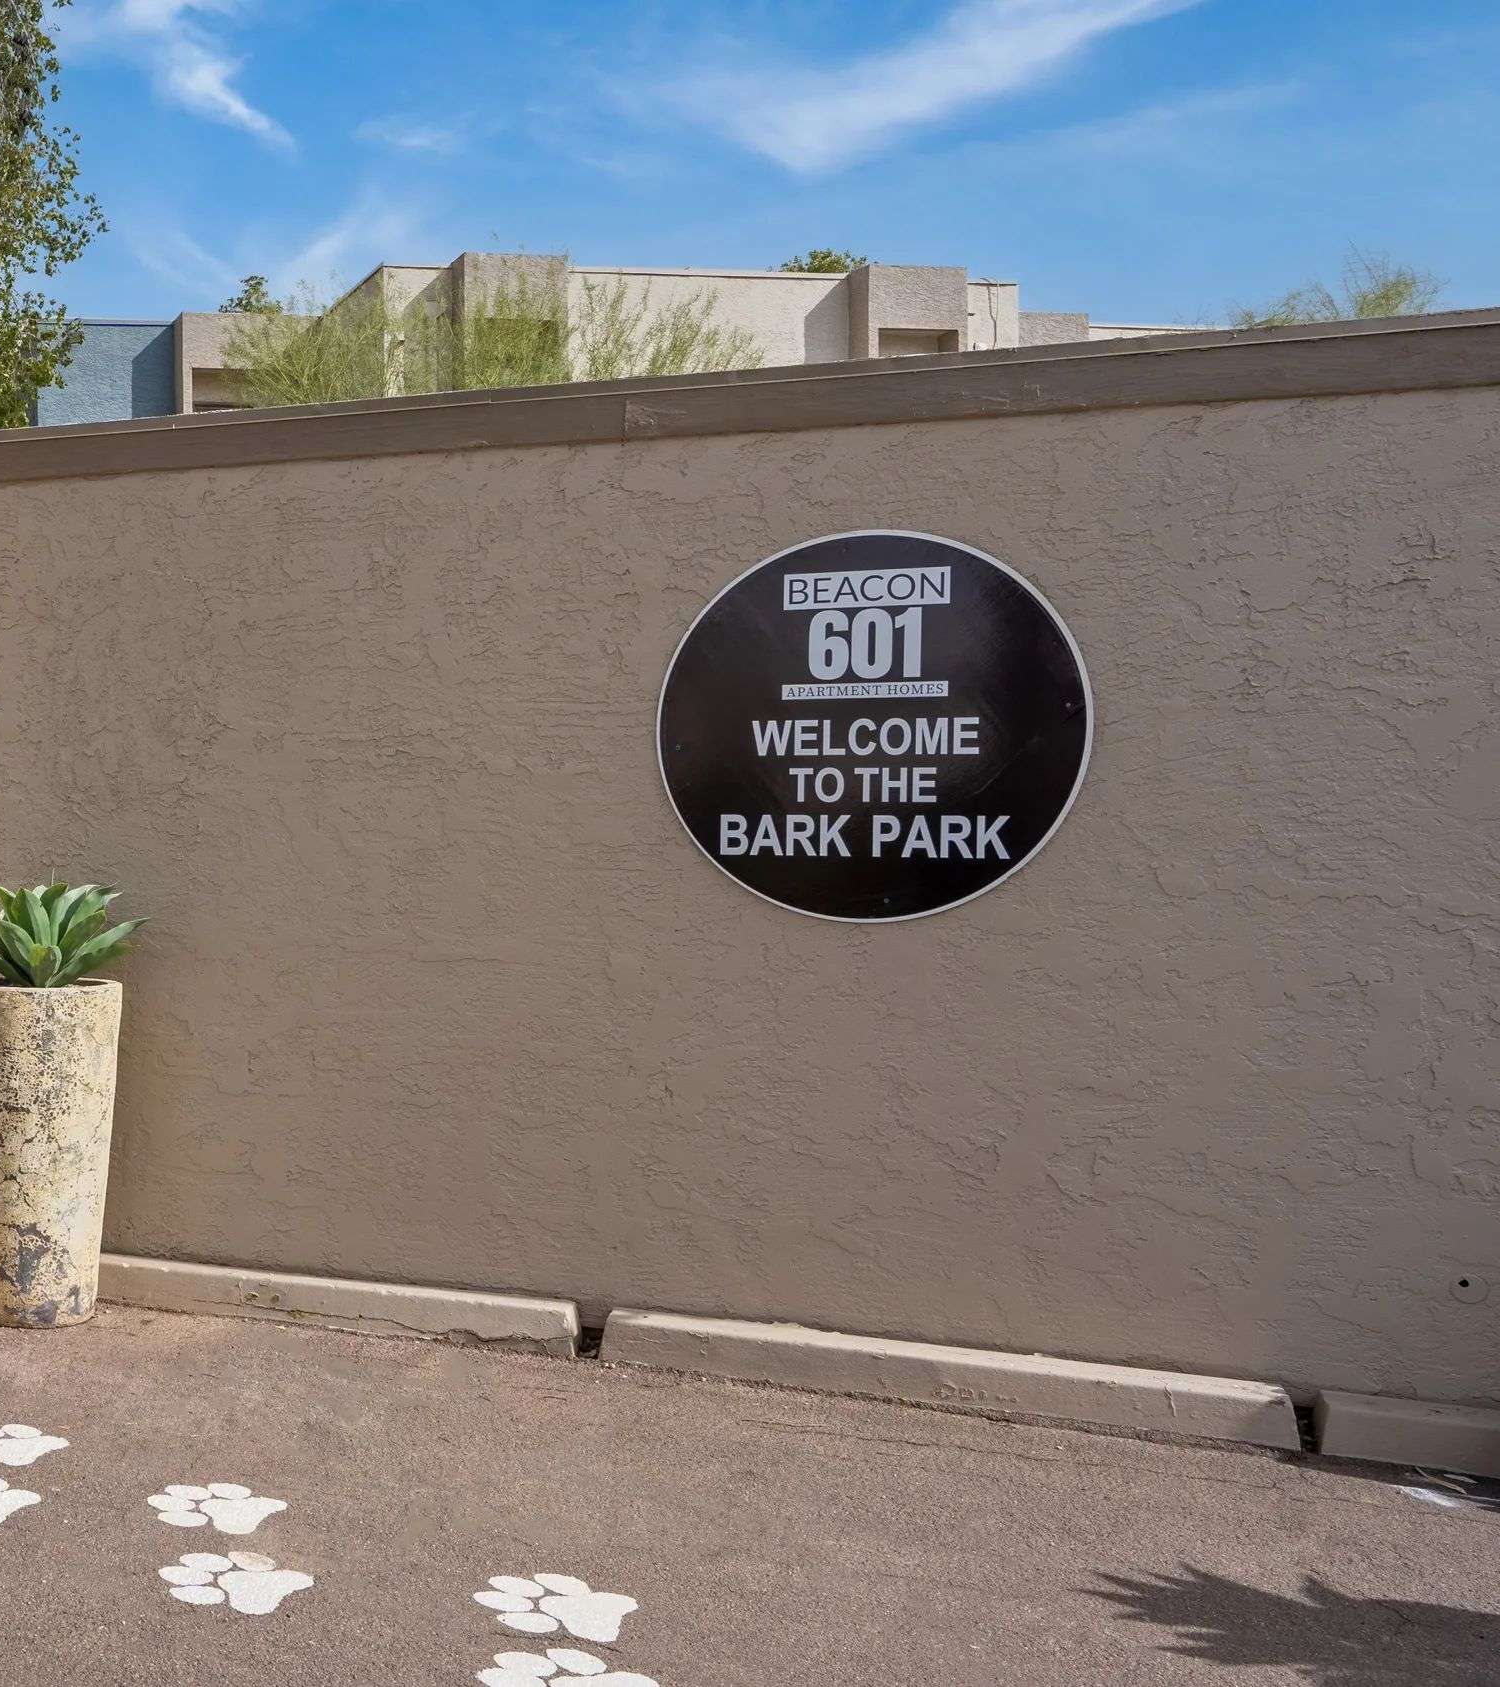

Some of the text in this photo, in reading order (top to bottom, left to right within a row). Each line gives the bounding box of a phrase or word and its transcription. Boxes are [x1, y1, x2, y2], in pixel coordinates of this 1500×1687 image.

[788, 571, 946, 605] BEACON
[808, 606, 923, 681] 601
[786, 683, 944, 698] APARTMENT HOMES
[751, 717, 980, 757] WELCOME
[788, 766, 938, 803] TO THE
[719, 813, 1011, 860] BARK PARK
